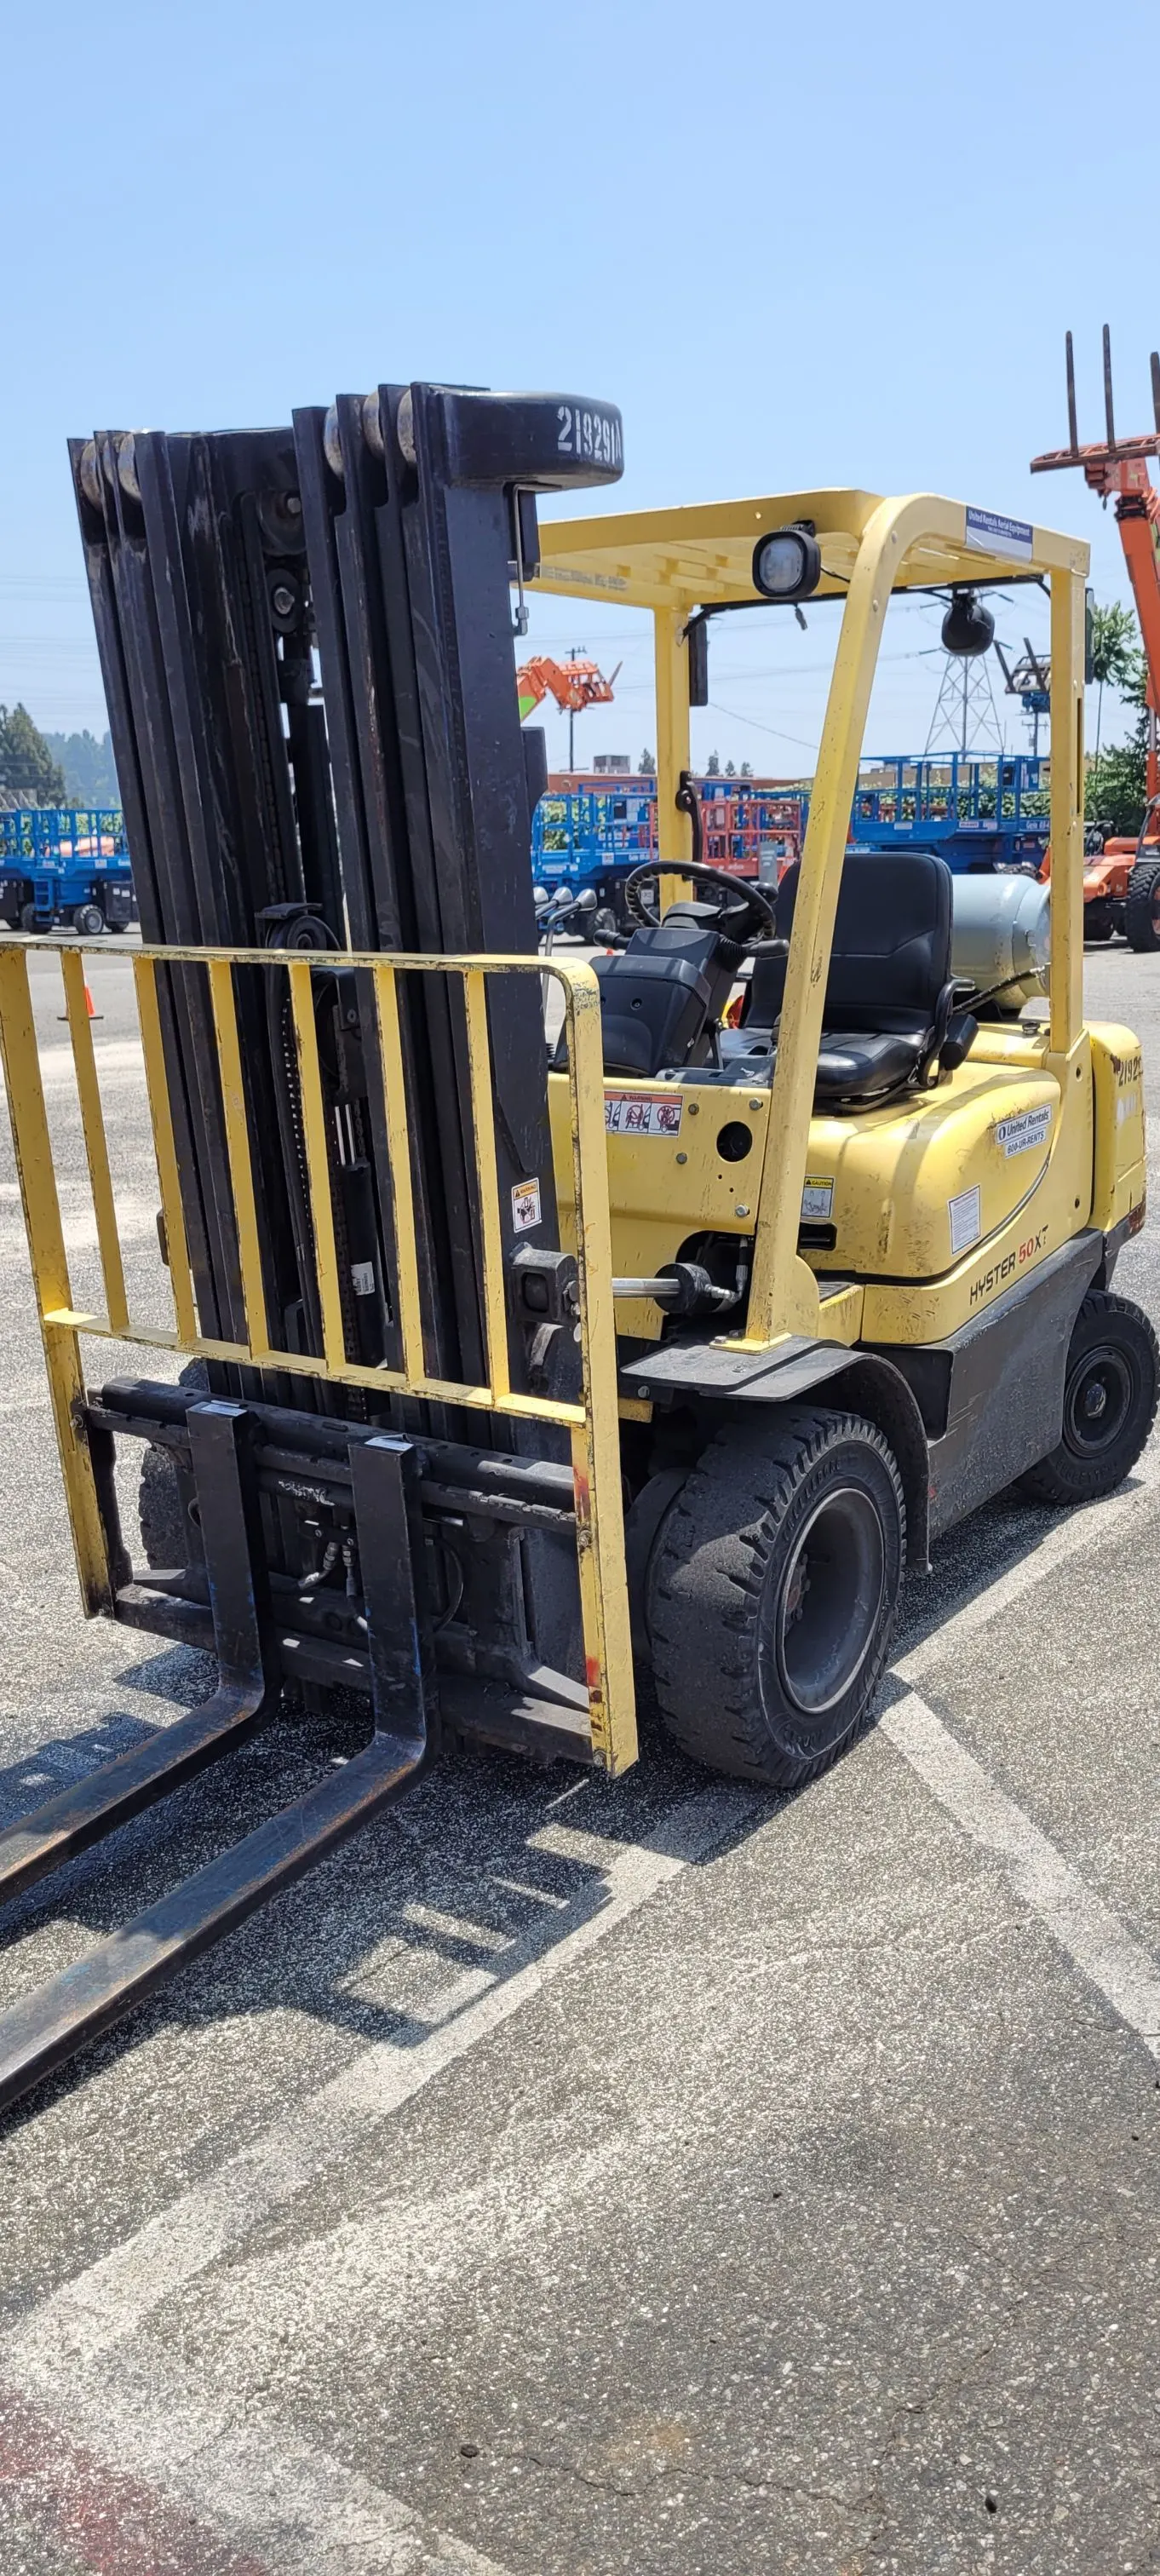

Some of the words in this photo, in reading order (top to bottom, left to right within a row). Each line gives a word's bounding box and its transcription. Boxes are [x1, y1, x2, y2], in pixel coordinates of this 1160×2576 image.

[1007, 1118, 1028, 1136] United
[1027, 1109, 1050, 1128] Rentals
[969, 1251, 1016, 1306] HYSTER
